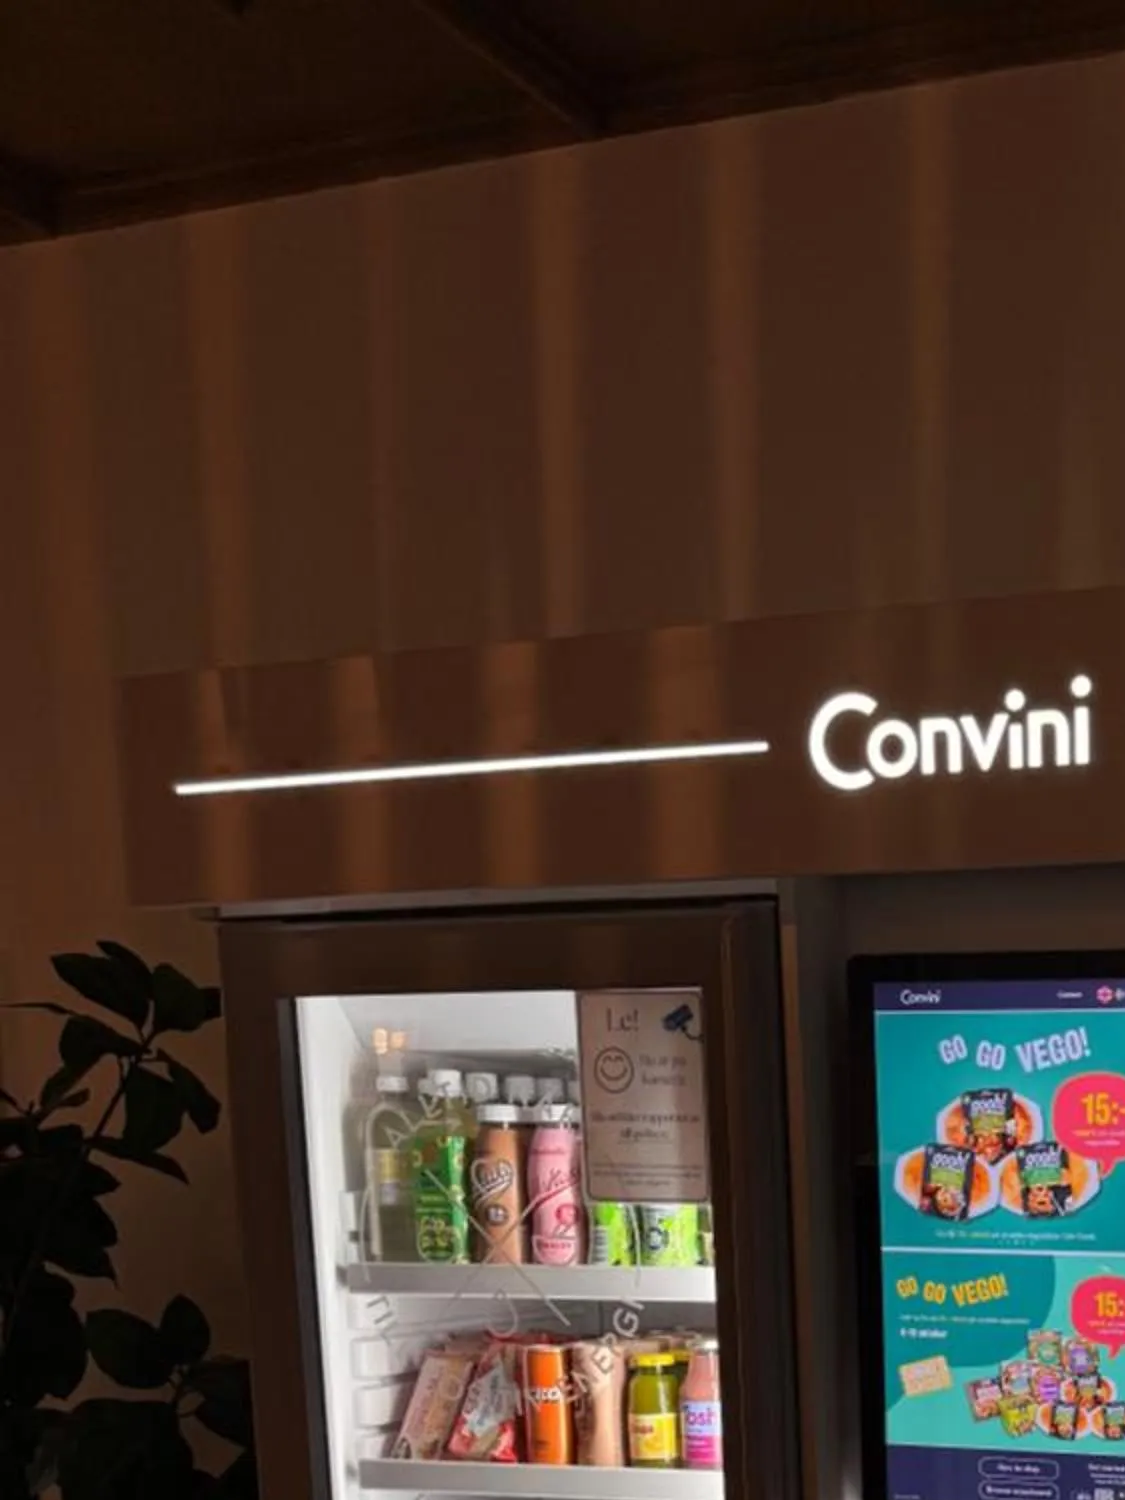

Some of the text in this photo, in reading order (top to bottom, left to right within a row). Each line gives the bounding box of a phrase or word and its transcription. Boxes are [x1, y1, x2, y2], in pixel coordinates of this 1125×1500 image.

[809, 674, 1092, 790] Convini
[900, 989, 941, 1005] Convini
[938, 1027, 1091, 1073] GO GO VEGO!
[896, 1273, 1009, 1307] GO GO VEGO!
